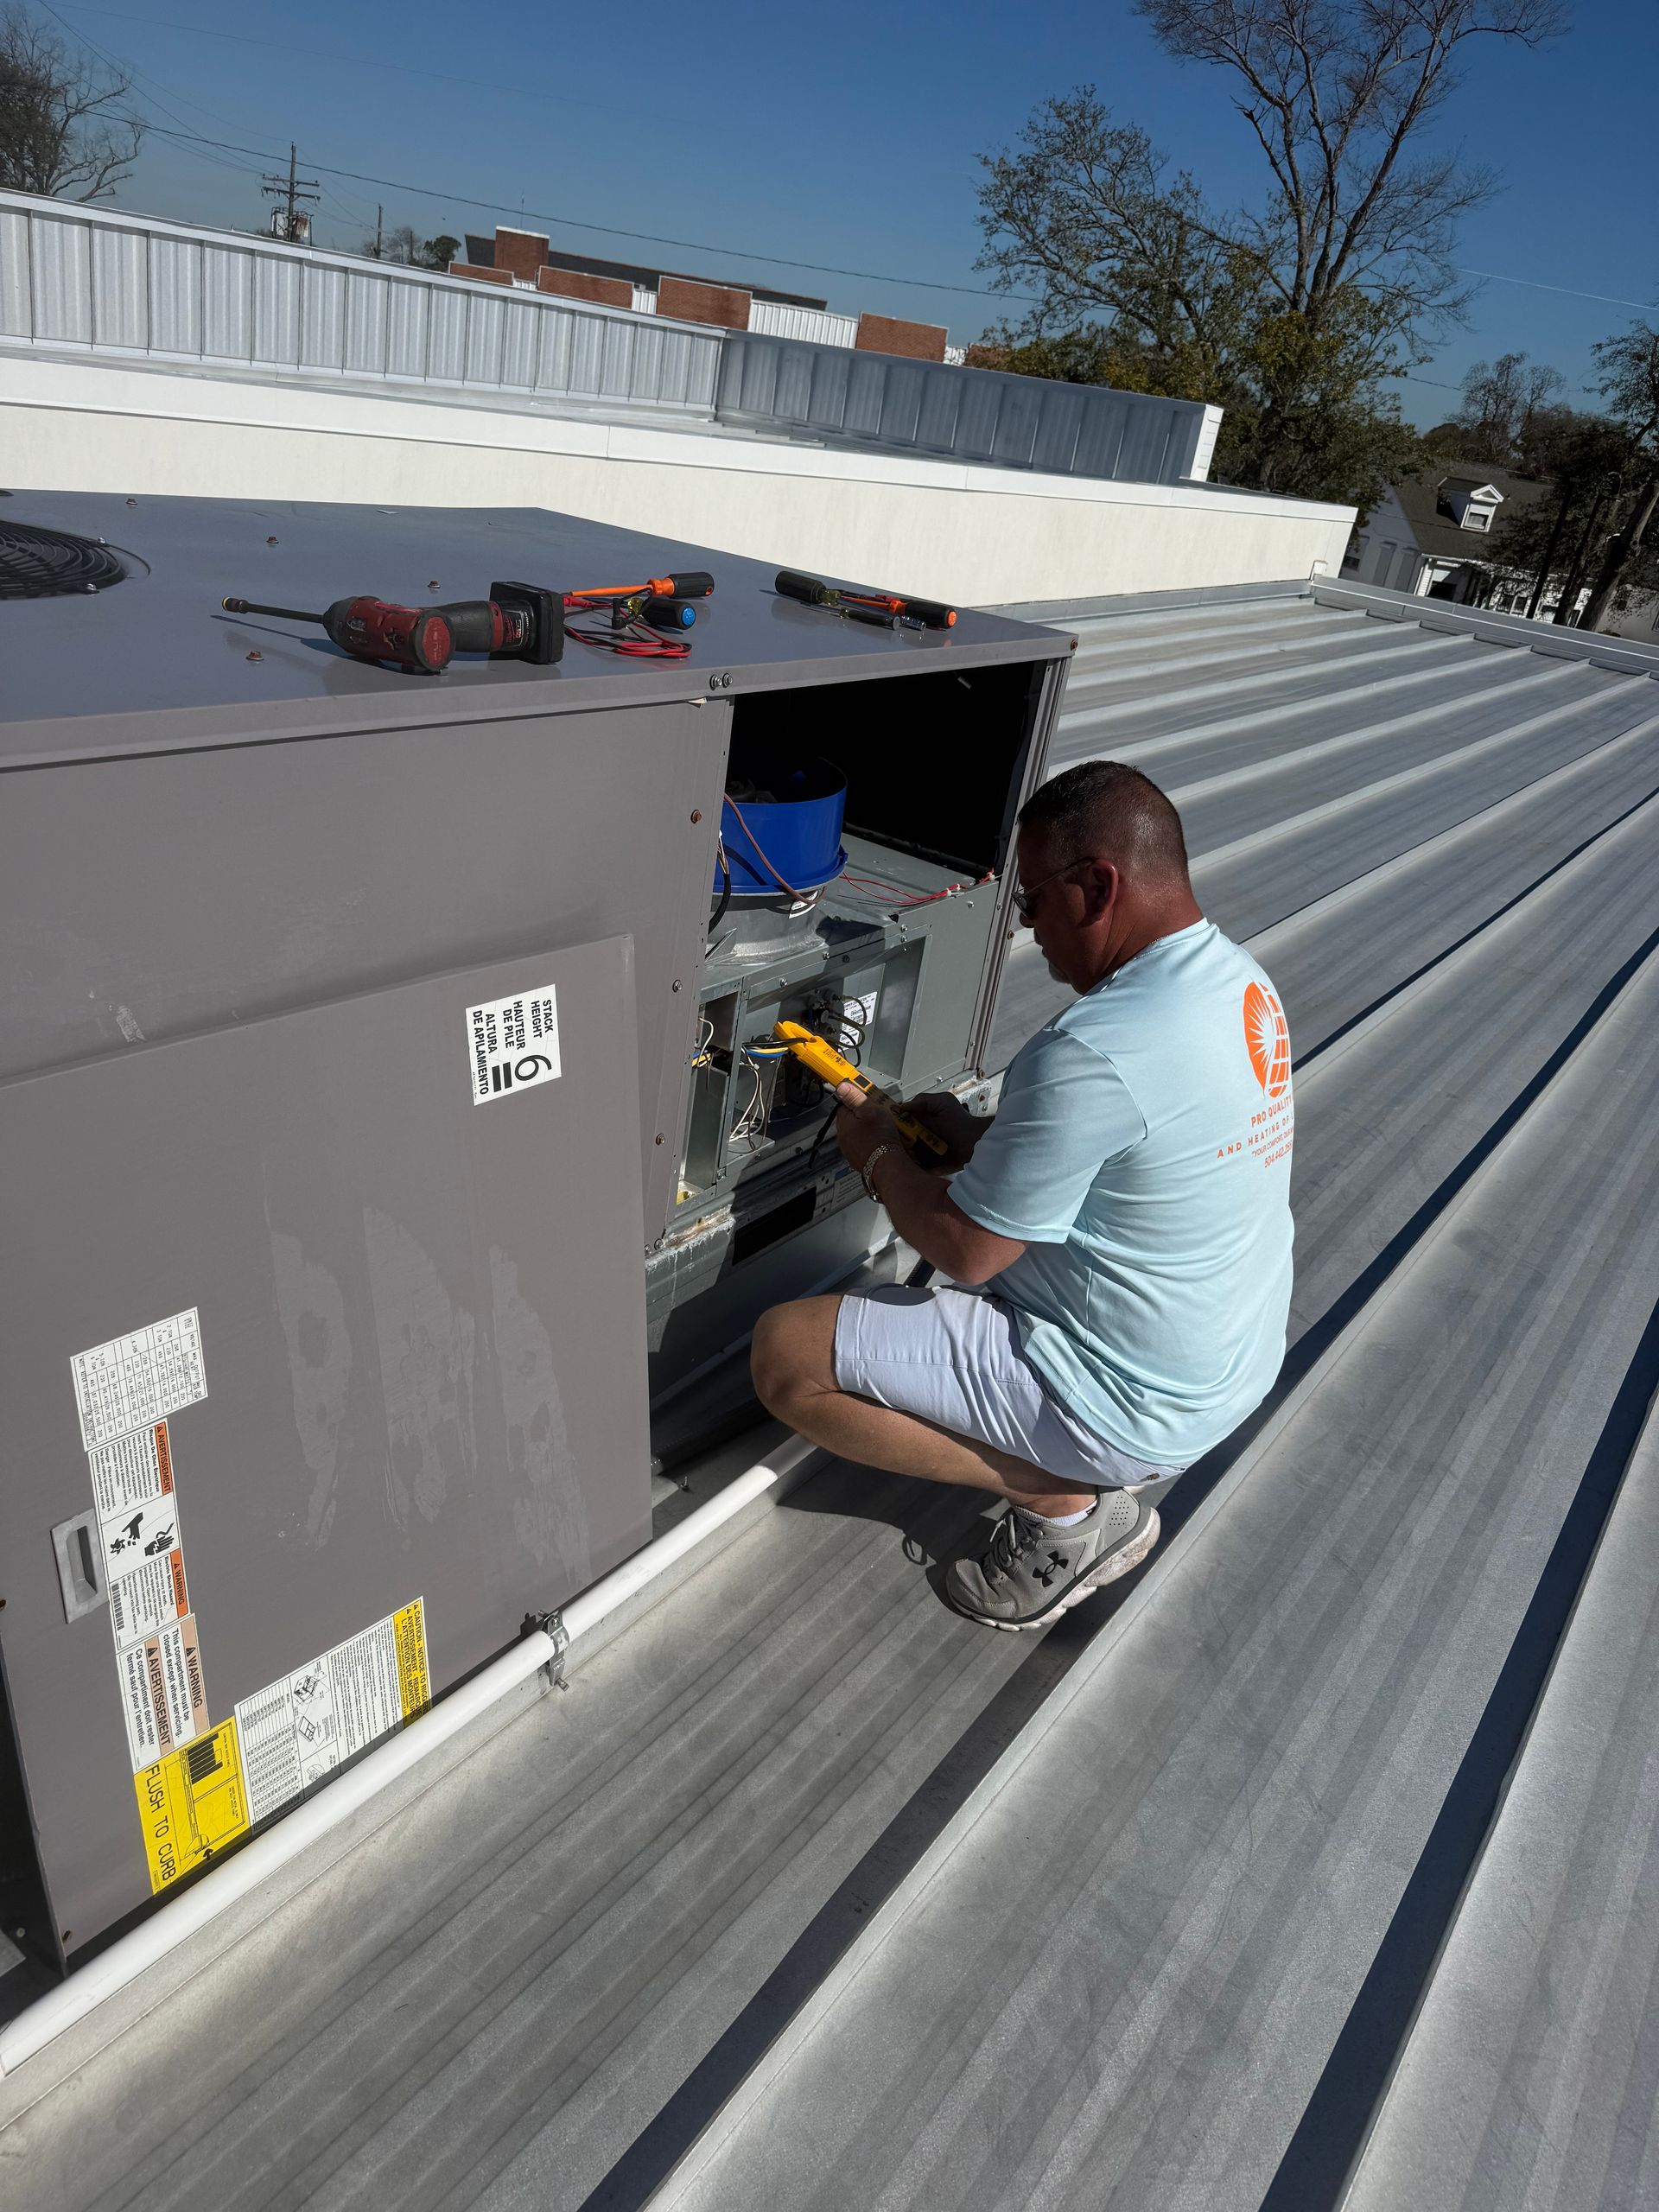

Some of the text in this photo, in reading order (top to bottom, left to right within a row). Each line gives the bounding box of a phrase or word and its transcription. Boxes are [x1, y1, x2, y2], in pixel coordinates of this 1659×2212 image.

[473, 1009, 483, 1025] DE
[484, 1012, 498, 1053] ALTURA
[502, 1008, 514, 1048] DE PILE
[512, 1000, 526, 1050] HAUTEUR
[530, 1000, 542, 1039] HEIGHT
[542, 998, 553, 1033] STACK
[473, 1026, 490, 1095] APILAMIENTO
[514, 1055, 552, 1081] 6
[1251, 1110, 1267, 1128] PRO
[1217, 1141, 1242, 1159] AND
[1248, 1122, 1280, 1146] HEATING
[157, 1433, 170, 1492] AVERTISSEMENT
[175, 1568, 185, 1605] WARNING
[126, 1652, 136, 1675] fermé
[129, 1674, 137, 1692] sauf
[171, 1627, 190, 1721] This compartment must be
[187, 1654, 202, 1709] WARNING
[401, 1617, 410, 1664] L'ATTENTION
[406, 1679, 415, 1719] MONTEURS
[407, 1614, 417, 1673] AVERTISSEMENT
[412, 1675, 421, 1716] REMARQUE
[419, 1672, 425, 1684] TO
[130, 1692, 139, 1711] pour
[135, 1647, 155, 1746] Ce compartiment doit rester
[149, 1655, 170, 1747] AVERTISSEMENT
[162, 1632, 183, 1738] closed except when servicing.
[134, 1708, 146, 1748] l'entretien.
[143, 1764, 176, 1882] FLUSH TO CURB
